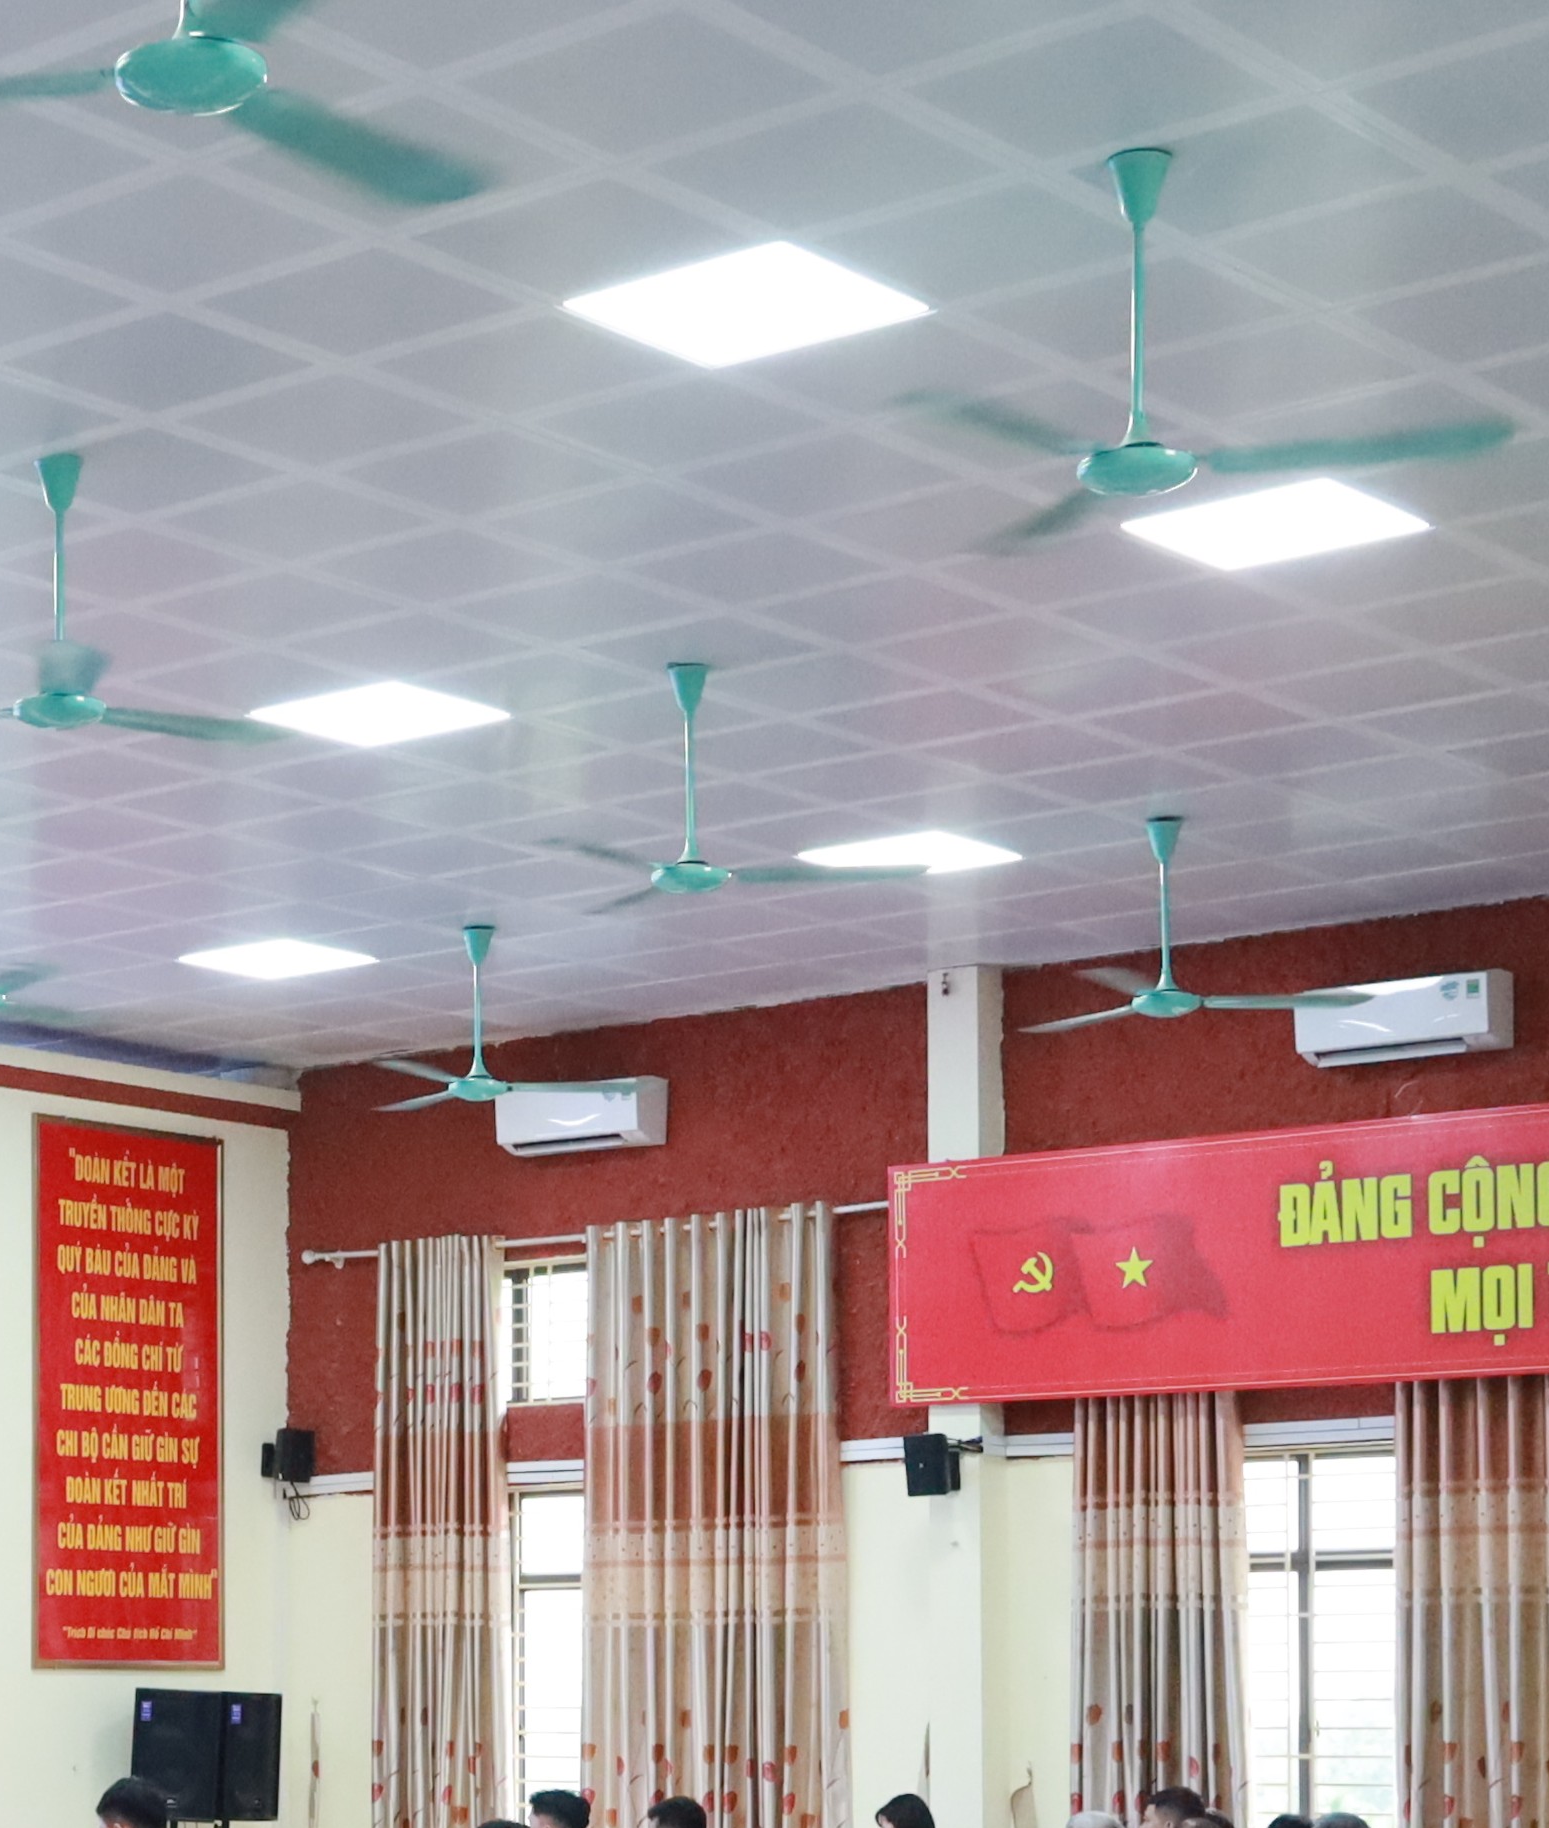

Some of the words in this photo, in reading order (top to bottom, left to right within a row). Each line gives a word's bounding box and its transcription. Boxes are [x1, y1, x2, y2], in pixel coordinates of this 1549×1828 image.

[114, 1150, 136, 1186] KẾT
[140, 1164, 154, 1189] LÀ
[159, 1163, 184, 1197] MỘT
[59, 1194, 106, 1229] TRUYỀN
[156, 1210, 179, 1241] CỰC
[1278, 1162, 1412, 1246] ĐẢNG
[58, 1242, 81, 1273] QUÝ
[86, 1244, 111, 1275] BÁU
[115, 1243, 139, 1278] CỦA
[143, 1247, 177, 1282] ĐẢNG
[182, 1256, 196, 1283] VÀ
[72, 1283, 97, 1319] CỦA
[101, 1292, 135, 1323] NHÂN
[139, 1297, 165, 1326] DÂN
[169, 1303, 184, 1328] TA
[1430, 1264, 1534, 1344] MỌI
[75, 1336, 100, 1366] CÁC
[104, 1331, 138, 1369] ĐỒNG
[142, 1345, 162, 1371] CHÍ
[166, 1344, 183, 1372] TỪ
[60, 1384, 101, 1412] TRUNG
[105, 1385, 139, 1414] ƯƠNG
[143, 1382, 168, 1417] ĐẾN
[172, 1389, 197, 1420] CÁC
[57, 1429, 78, 1456] CHI
[82, 1427, 98, 1463] BỘ
[102, 1424, 128, 1459] CẦN
[132, 1430, 154, 1461] GIỮ
[157, 1433, 178, 1462] GÌN
[182, 1437, 199, 1468] SỰ
[66, 1472, 101, 1504] ĐOÀN
[104, 1468, 127, 1505] KẾT
[132, 1471, 164, 1506] NHẤT
[167, 1481, 186, 1508] TRÍ
[58, 1514, 83, 1549] CỦA
[87, 1515, 122, 1551] ĐẢNG
[126, 1526, 153, 1552] NHƯ
[154, 1523, 176, 1553] GIỮ
[179, 1524, 200, 1554] GÌN
[46, 1568, 73, 1595] CON
[119, 1563, 144, 1597] CỦA
[149, 1564, 175, 1598] MẮT
